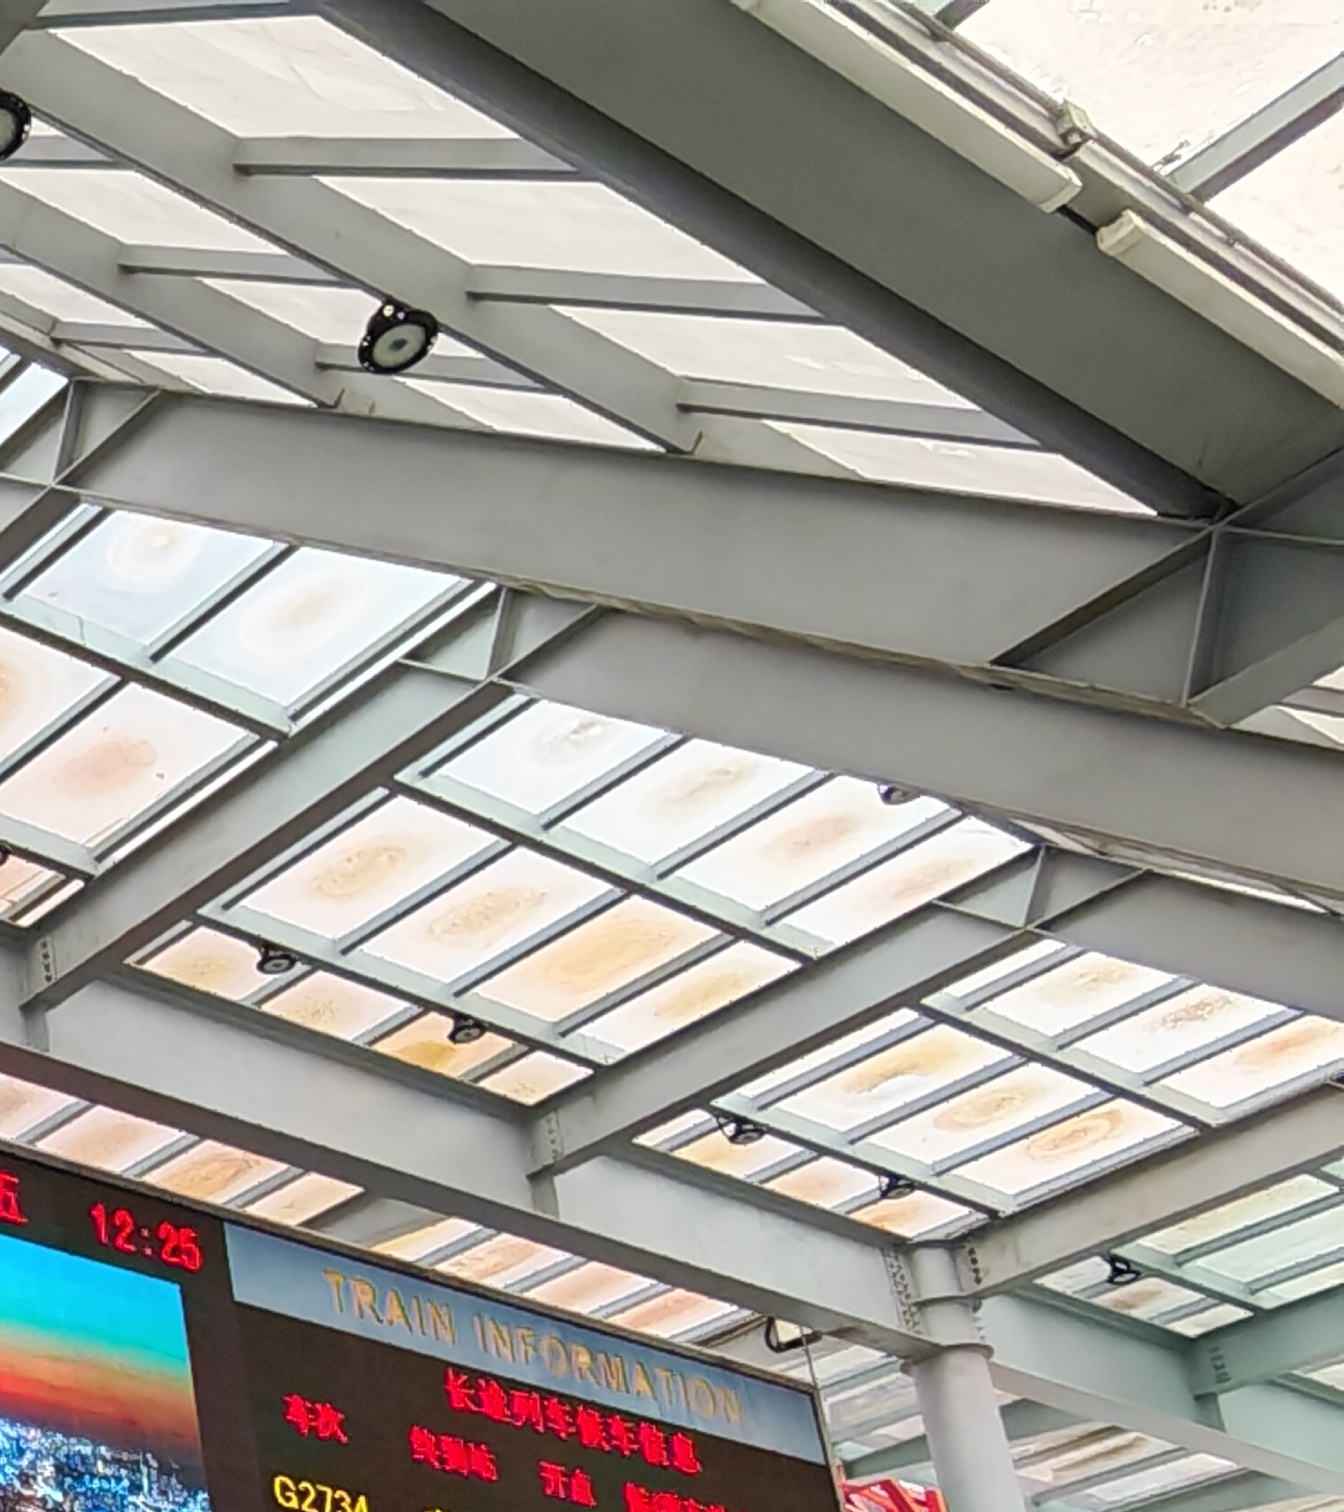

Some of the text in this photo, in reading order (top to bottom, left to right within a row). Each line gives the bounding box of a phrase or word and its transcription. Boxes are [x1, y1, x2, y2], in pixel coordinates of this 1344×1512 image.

[91, 1201, 204, 1274] 12:25
[323, 1268, 744, 1423] TRAIN INFORMATION
[282, 1392, 348, 1444] 车次
[538, 1459, 597, 1508] 开点
